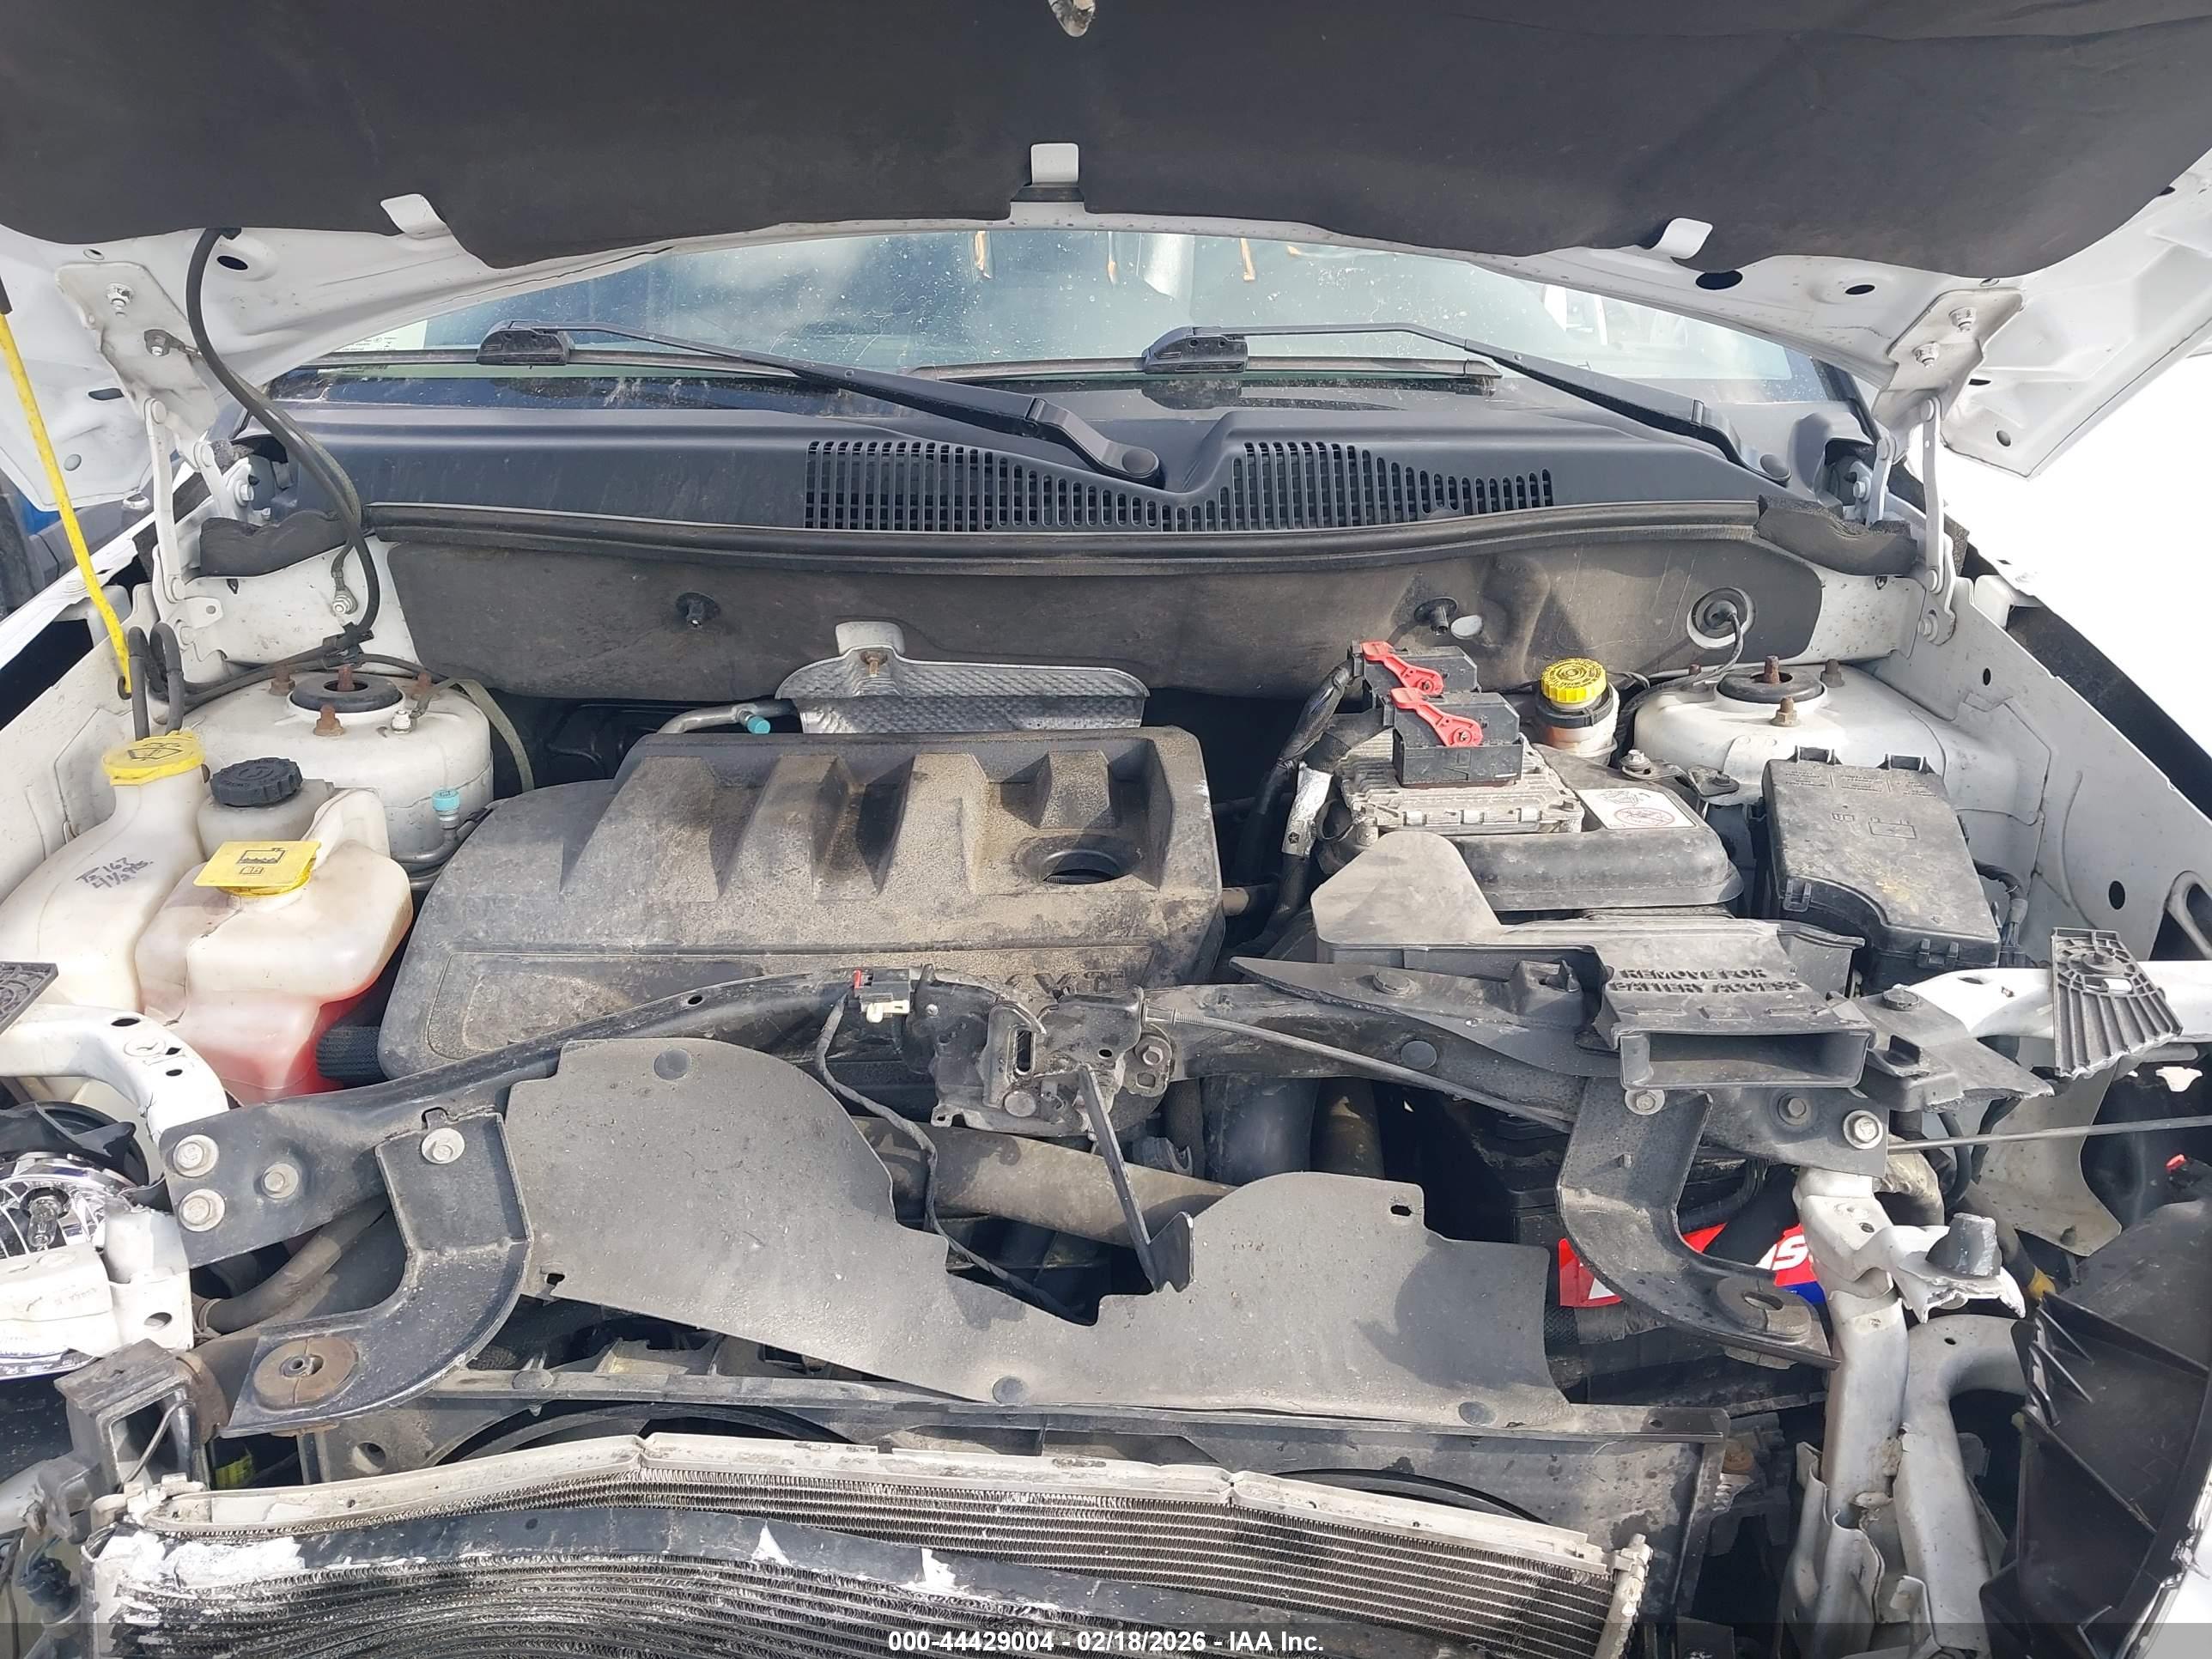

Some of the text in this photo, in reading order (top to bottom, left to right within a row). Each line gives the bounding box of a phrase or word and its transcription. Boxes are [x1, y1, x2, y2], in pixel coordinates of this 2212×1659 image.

[1620, 967, 1767, 981] REMOVE FOR
[1607, 980, 1804, 994] BATTERY ACCESS
